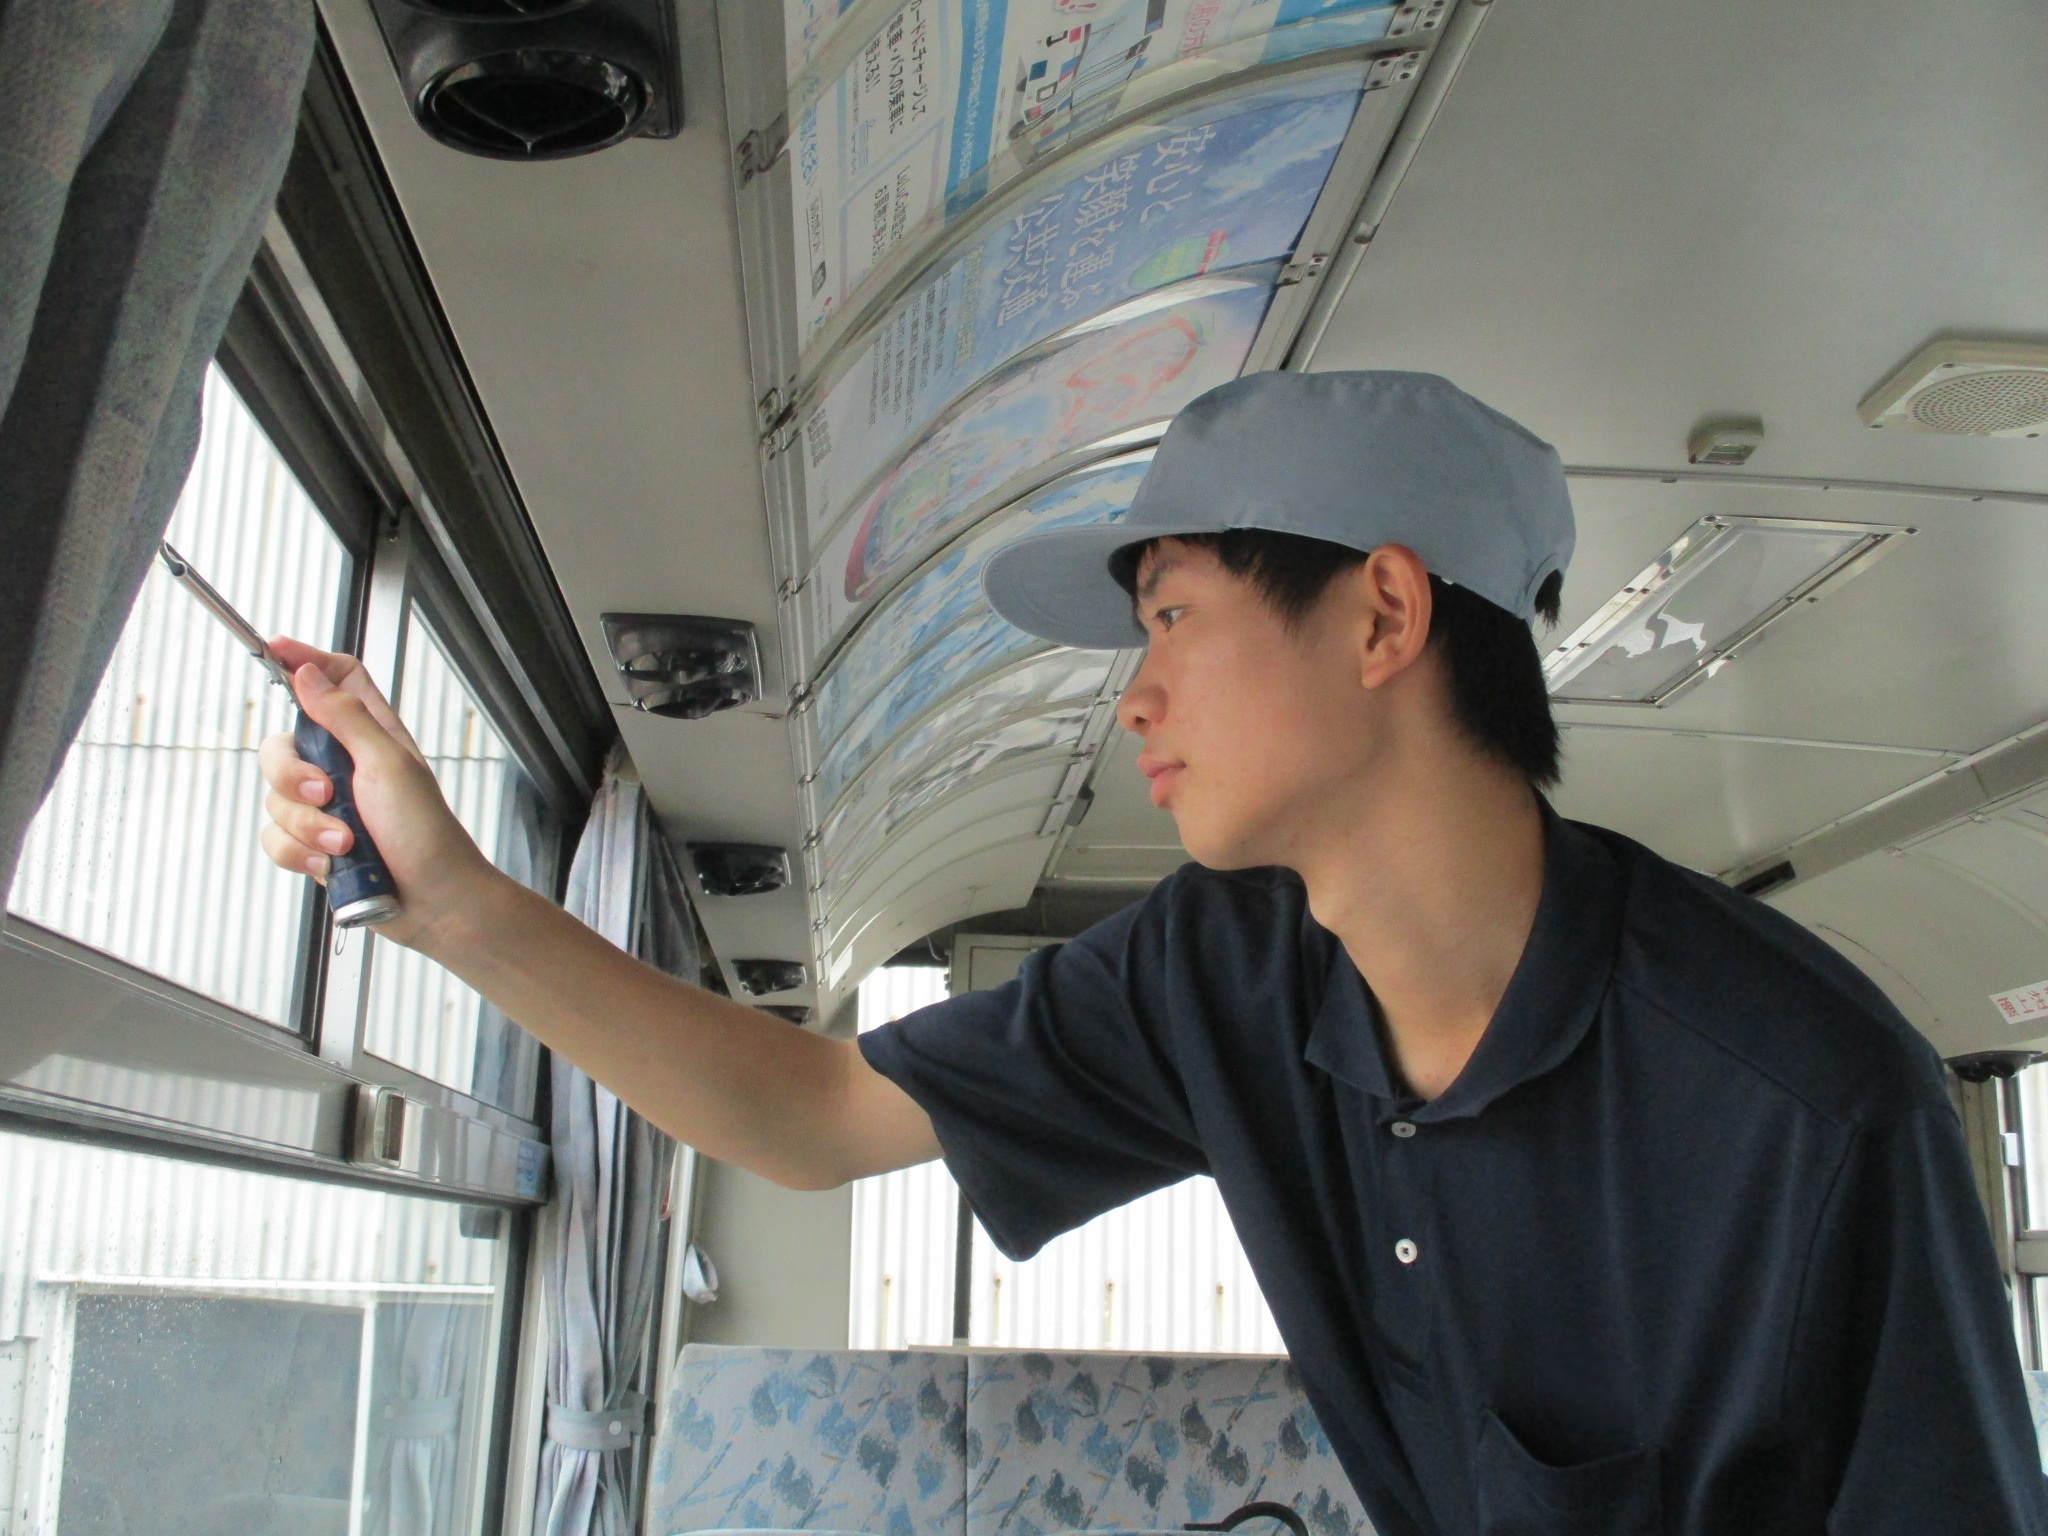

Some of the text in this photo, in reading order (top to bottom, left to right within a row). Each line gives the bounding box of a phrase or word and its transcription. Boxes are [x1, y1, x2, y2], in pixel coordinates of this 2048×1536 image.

[1060, 152, 1143, 310] 笑顔を運ぶ
[1139, 124, 1218, 223] 安心と
[997, 193, 1066, 326] 公共交通
